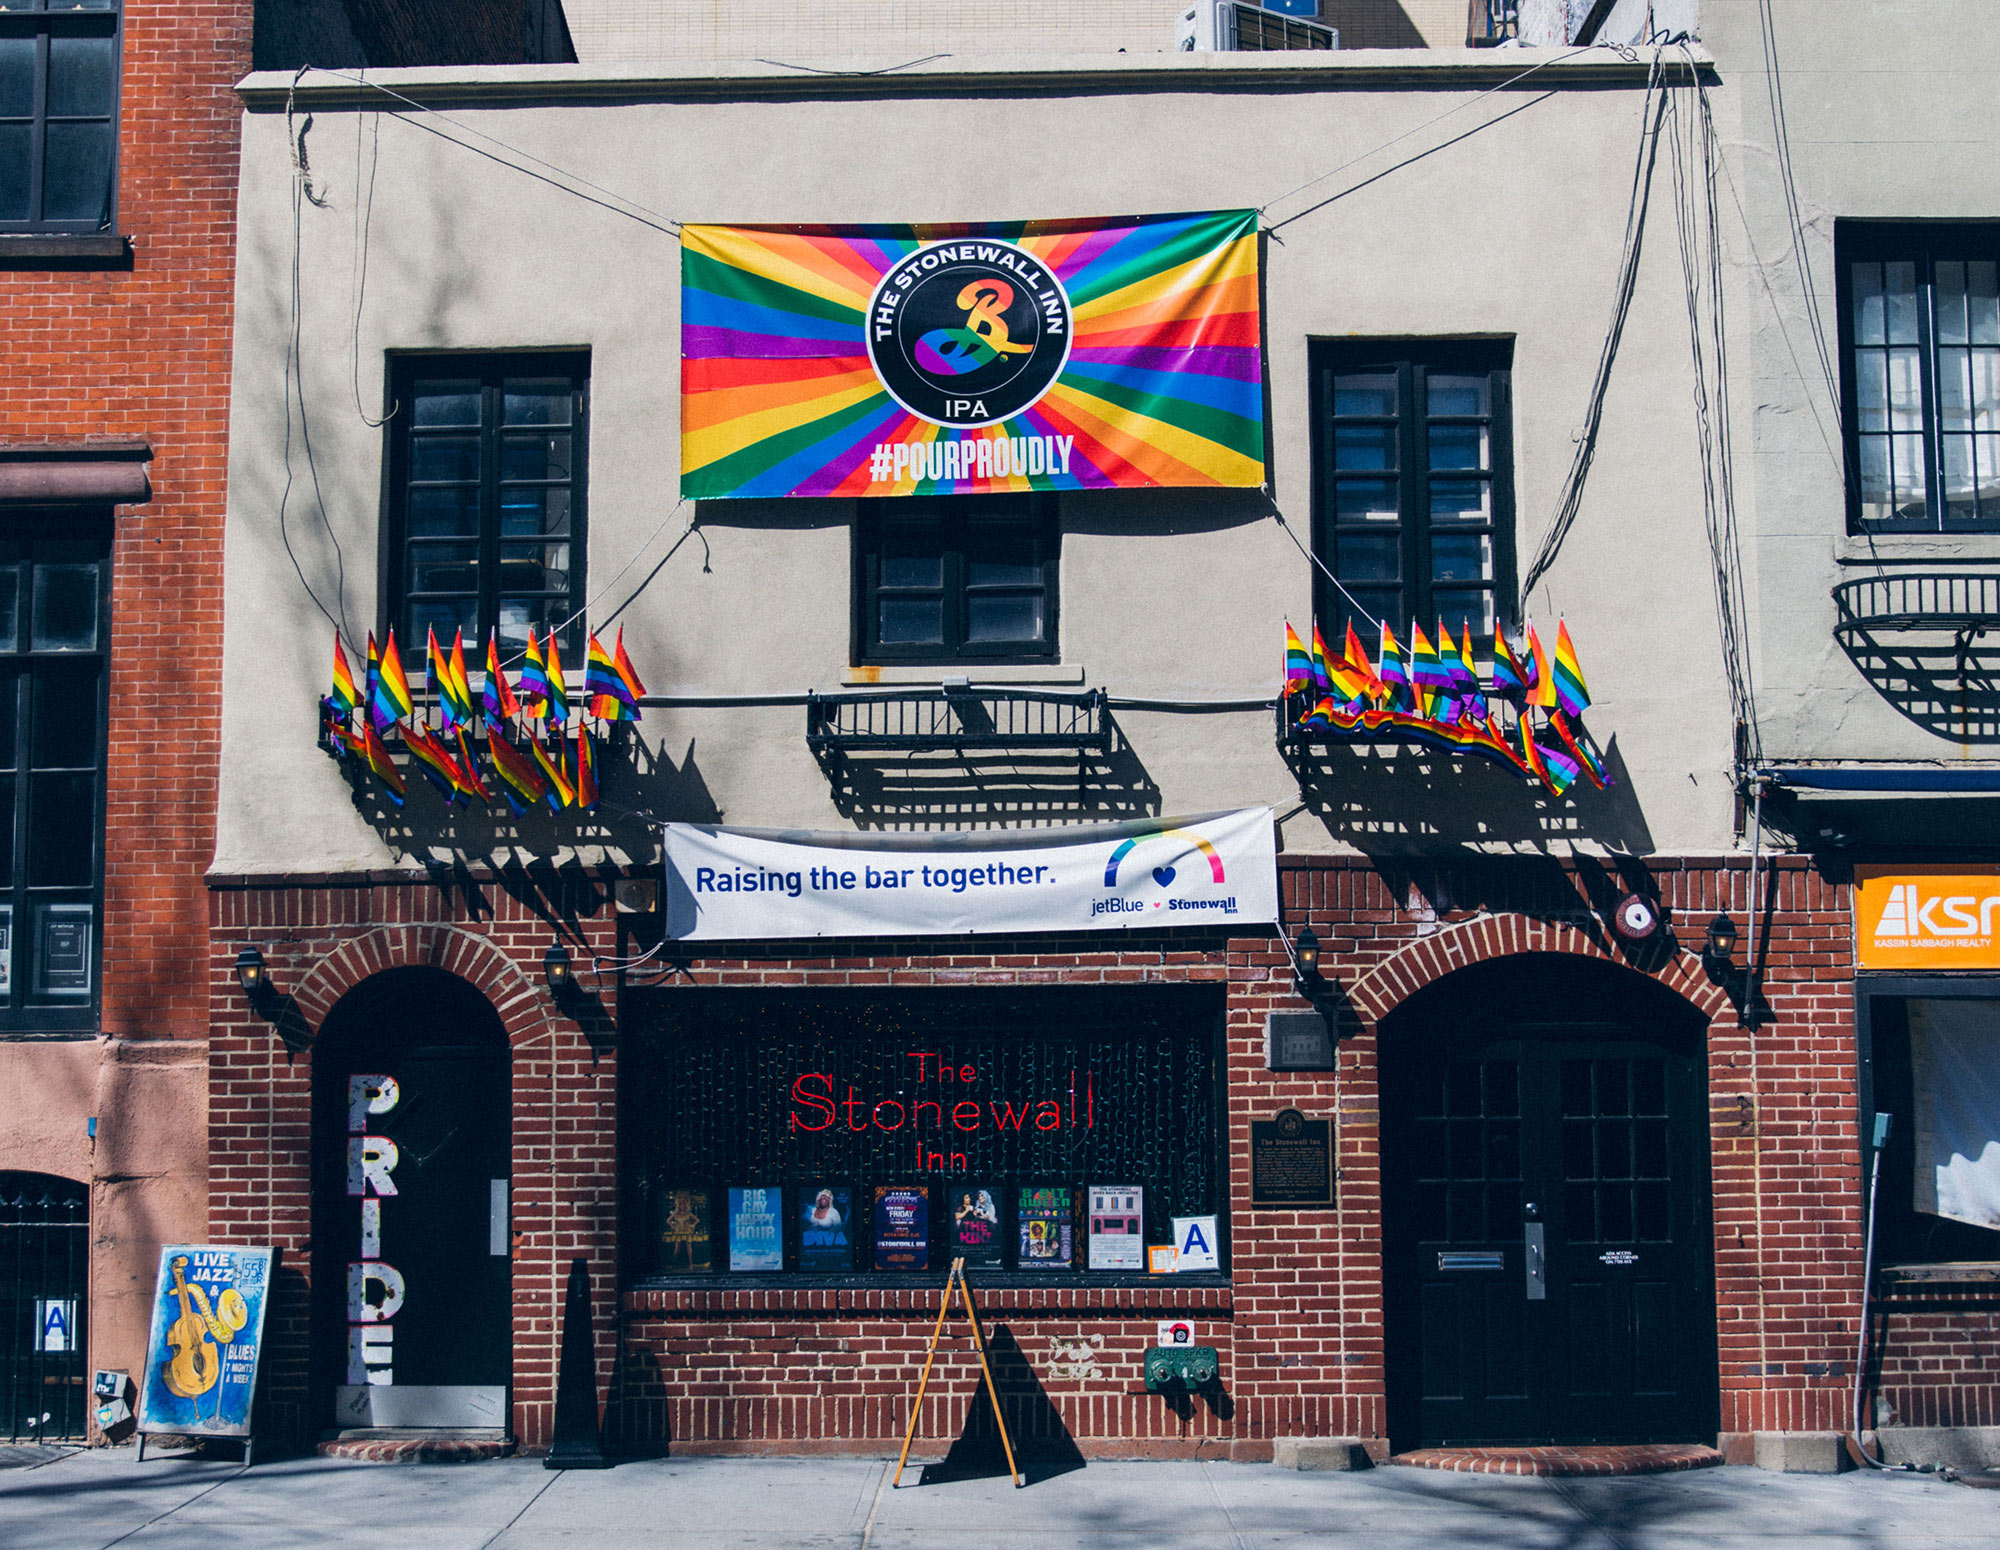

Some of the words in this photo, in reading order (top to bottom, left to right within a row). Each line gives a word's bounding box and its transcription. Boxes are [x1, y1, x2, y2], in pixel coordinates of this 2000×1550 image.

[876, 290, 901, 341] THE
[895, 245, 1042, 290] STONEWALL
[1038, 289, 1063, 335] INN
[945, 400, 990, 418] IPA
[869, 434, 1074, 482] #POURPROUDLY
[696, 866, 802, 898] Raising
[809, 865, 857, 890] the
[865, 864, 915, 889] bar
[921, 862, 1056, 893] together.
[1091, 897, 1144, 917] jetBlue
[1168, 896, 1236, 912] Stonewall
[1874, 938, 1909, 948] KASSIN
[1910, 938, 1955, 948] SABBAGH
[1956, 938, 1992, 948] REALTY
[907, 1052, 977, 1083] The
[791, 1069, 1092, 1132] Stonewall
[917, 1140, 967, 1170] Inn
[743, 1189, 766, 1201] BIG
[1022, 1187, 1033, 1199] 8
[1039, 1187, 1067, 1199] BIT
[742, 1201, 767, 1214] GAY
[889, 1210, 914, 1218] FRIDAY
[735, 1213, 775, 1226] HAPPY
[963, 1221, 989, 1232] THE
[347, 1074, 405, 1386] PRIDE
[735, 1226, 775, 1240] HOUR
[803, 1231, 849, 1247] DIVA
[1182, 1223, 1210, 1254] A
[193, 1252, 230, 1267] LIVE
[192, 1267, 235, 1282] JAZZ
[244, 1262, 258, 1279] 55
[209, 1284, 220, 1297] &
[45, 1306, 69, 1336] A
[227, 1343, 256, 1361] BLUES
[1153, 1347, 1179, 1357] AUTO
[1183, 1347, 1209, 1357] SPKR
[225, 1363, 231, 1372] 7
[231, 1362, 254, 1373] NIGHTS
[225, 1373, 231, 1383] A
[232, 1373, 250, 1384] WEEK
